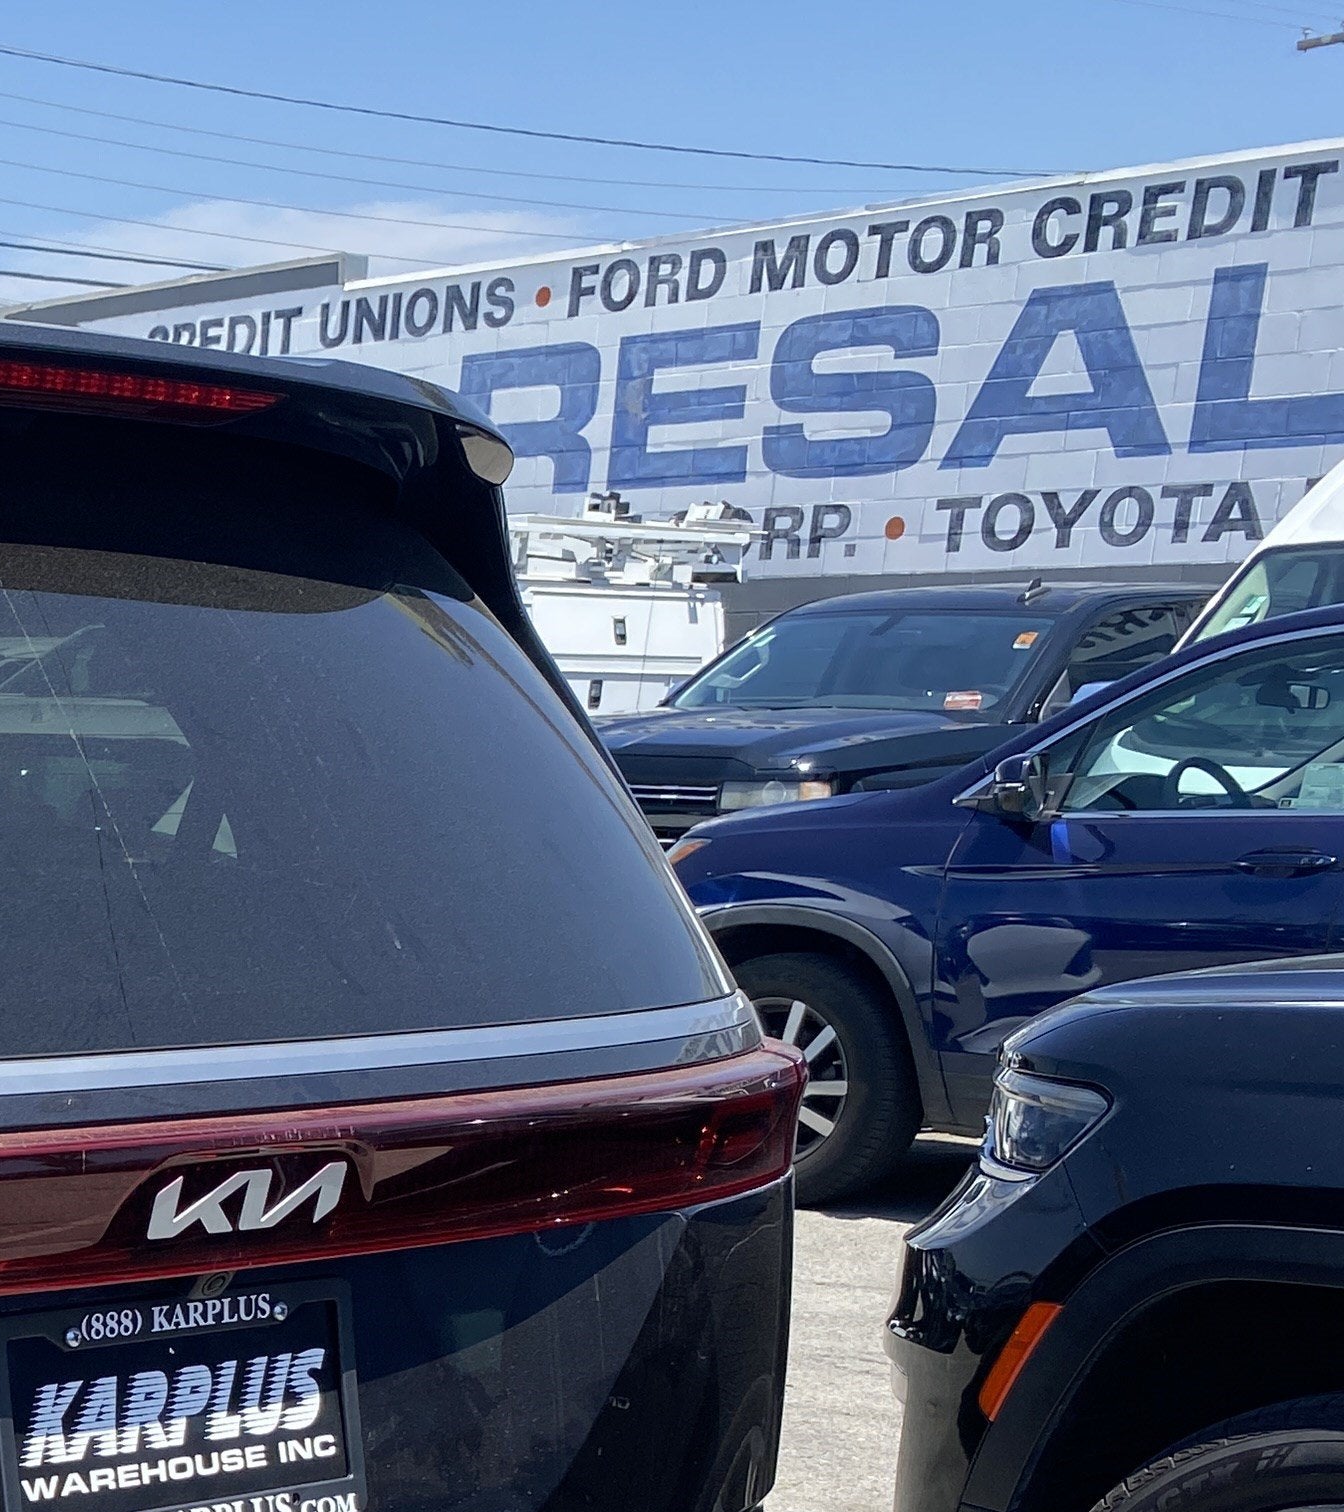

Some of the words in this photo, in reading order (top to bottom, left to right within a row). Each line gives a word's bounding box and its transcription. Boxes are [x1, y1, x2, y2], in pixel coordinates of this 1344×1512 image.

[318, 276, 516, 348] UNIONS
[567, 247, 728, 318] FORD
[749, 207, 1005, 294] MOTOR
[1031, 159, 1340, 259] CREDIT
[935, 482, 1265, 554] TOYOTA
[146, 1161, 347, 1240] KIA
[80, 1308, 143, 1341] (888)
[151, 1293, 272, 1334] KARPLUS
[18, 1347, 327, 1468] KARPLUS
[20, 1446, 268, 1502] WAREHOUSE
[278, 1434, 338, 1465] INC
